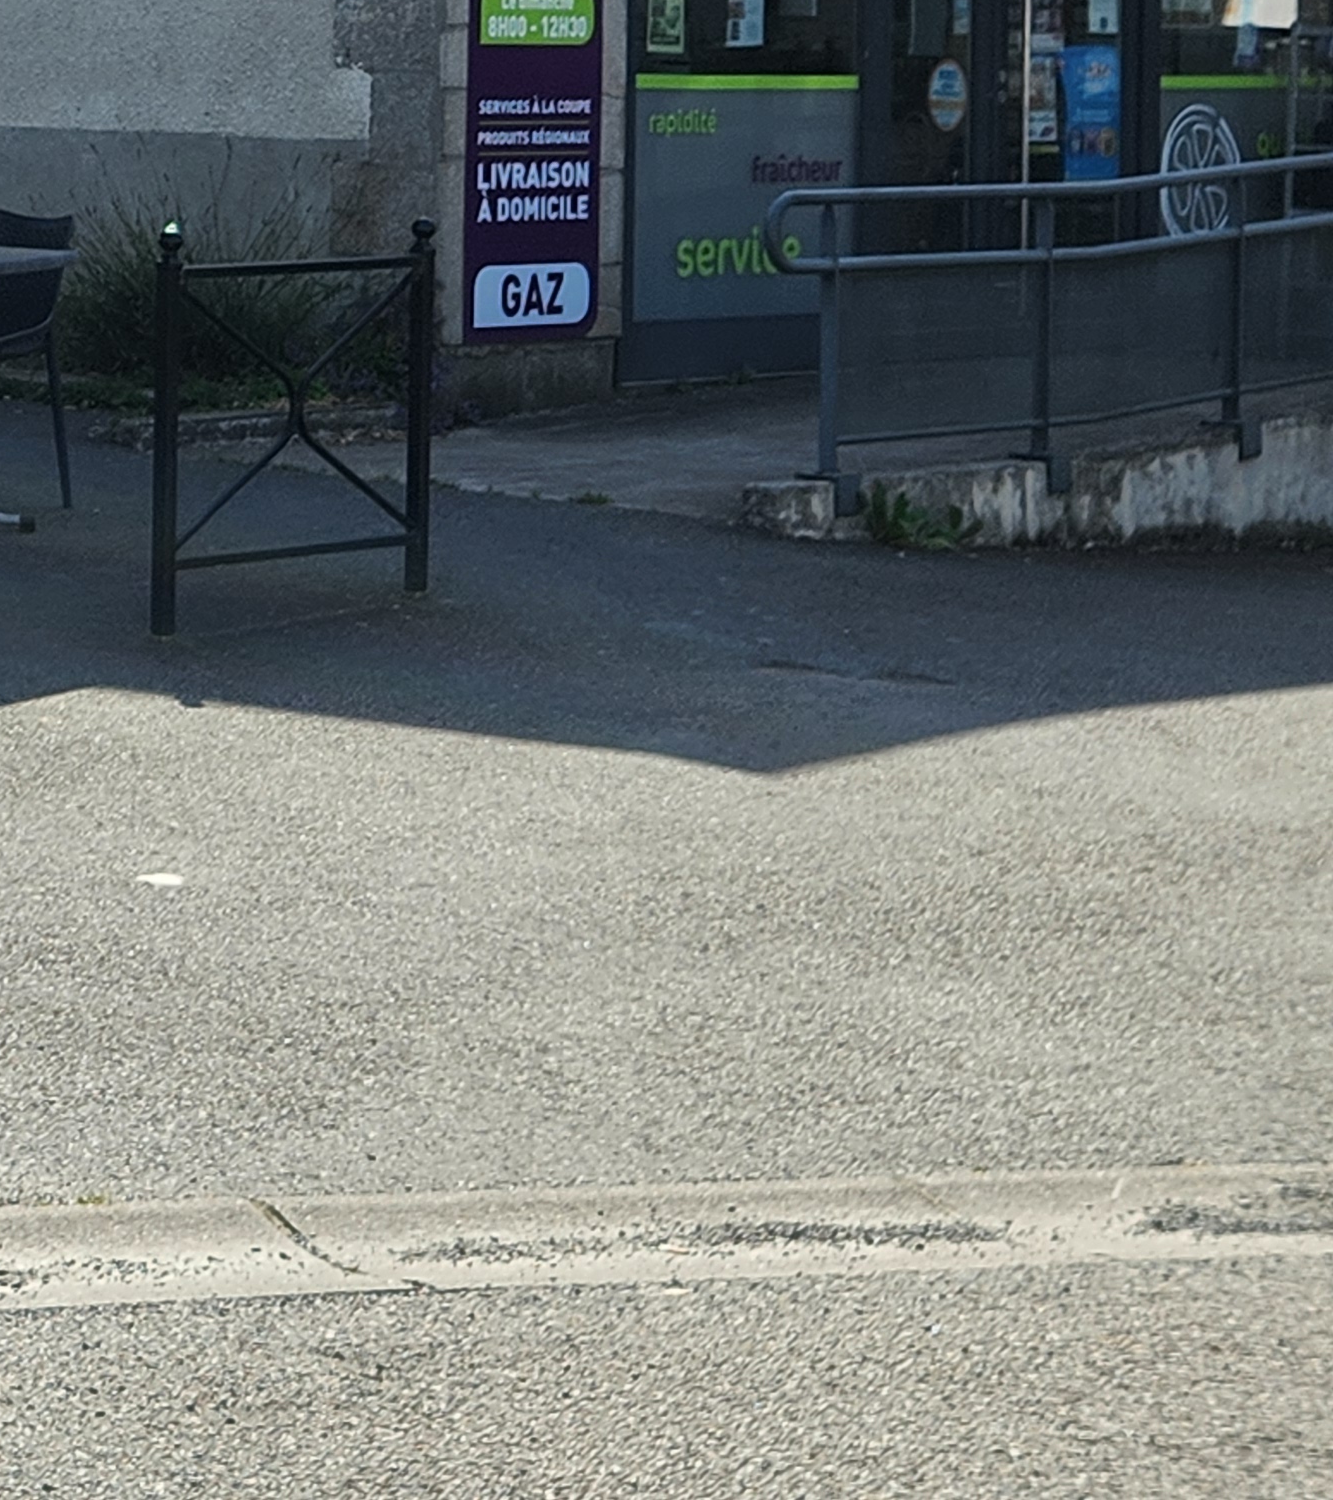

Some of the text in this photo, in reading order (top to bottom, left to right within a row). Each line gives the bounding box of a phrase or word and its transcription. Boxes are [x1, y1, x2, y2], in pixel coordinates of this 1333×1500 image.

[487, 15, 528, 38] 8H00
[540, 15, 588, 39] 12H30
[478, 95, 593, 115] SERVICES À LA COUPE
[476, 126, 591, 146] PRODUITS RÉGIONAUX
[648, 107, 718, 138] rapidité
[476, 160, 590, 191] LIVRAISON
[750, 153, 844, 184] fraîcheur
[476, 190, 590, 223] À DOMICILE
[501, 271, 565, 318] GAZ
